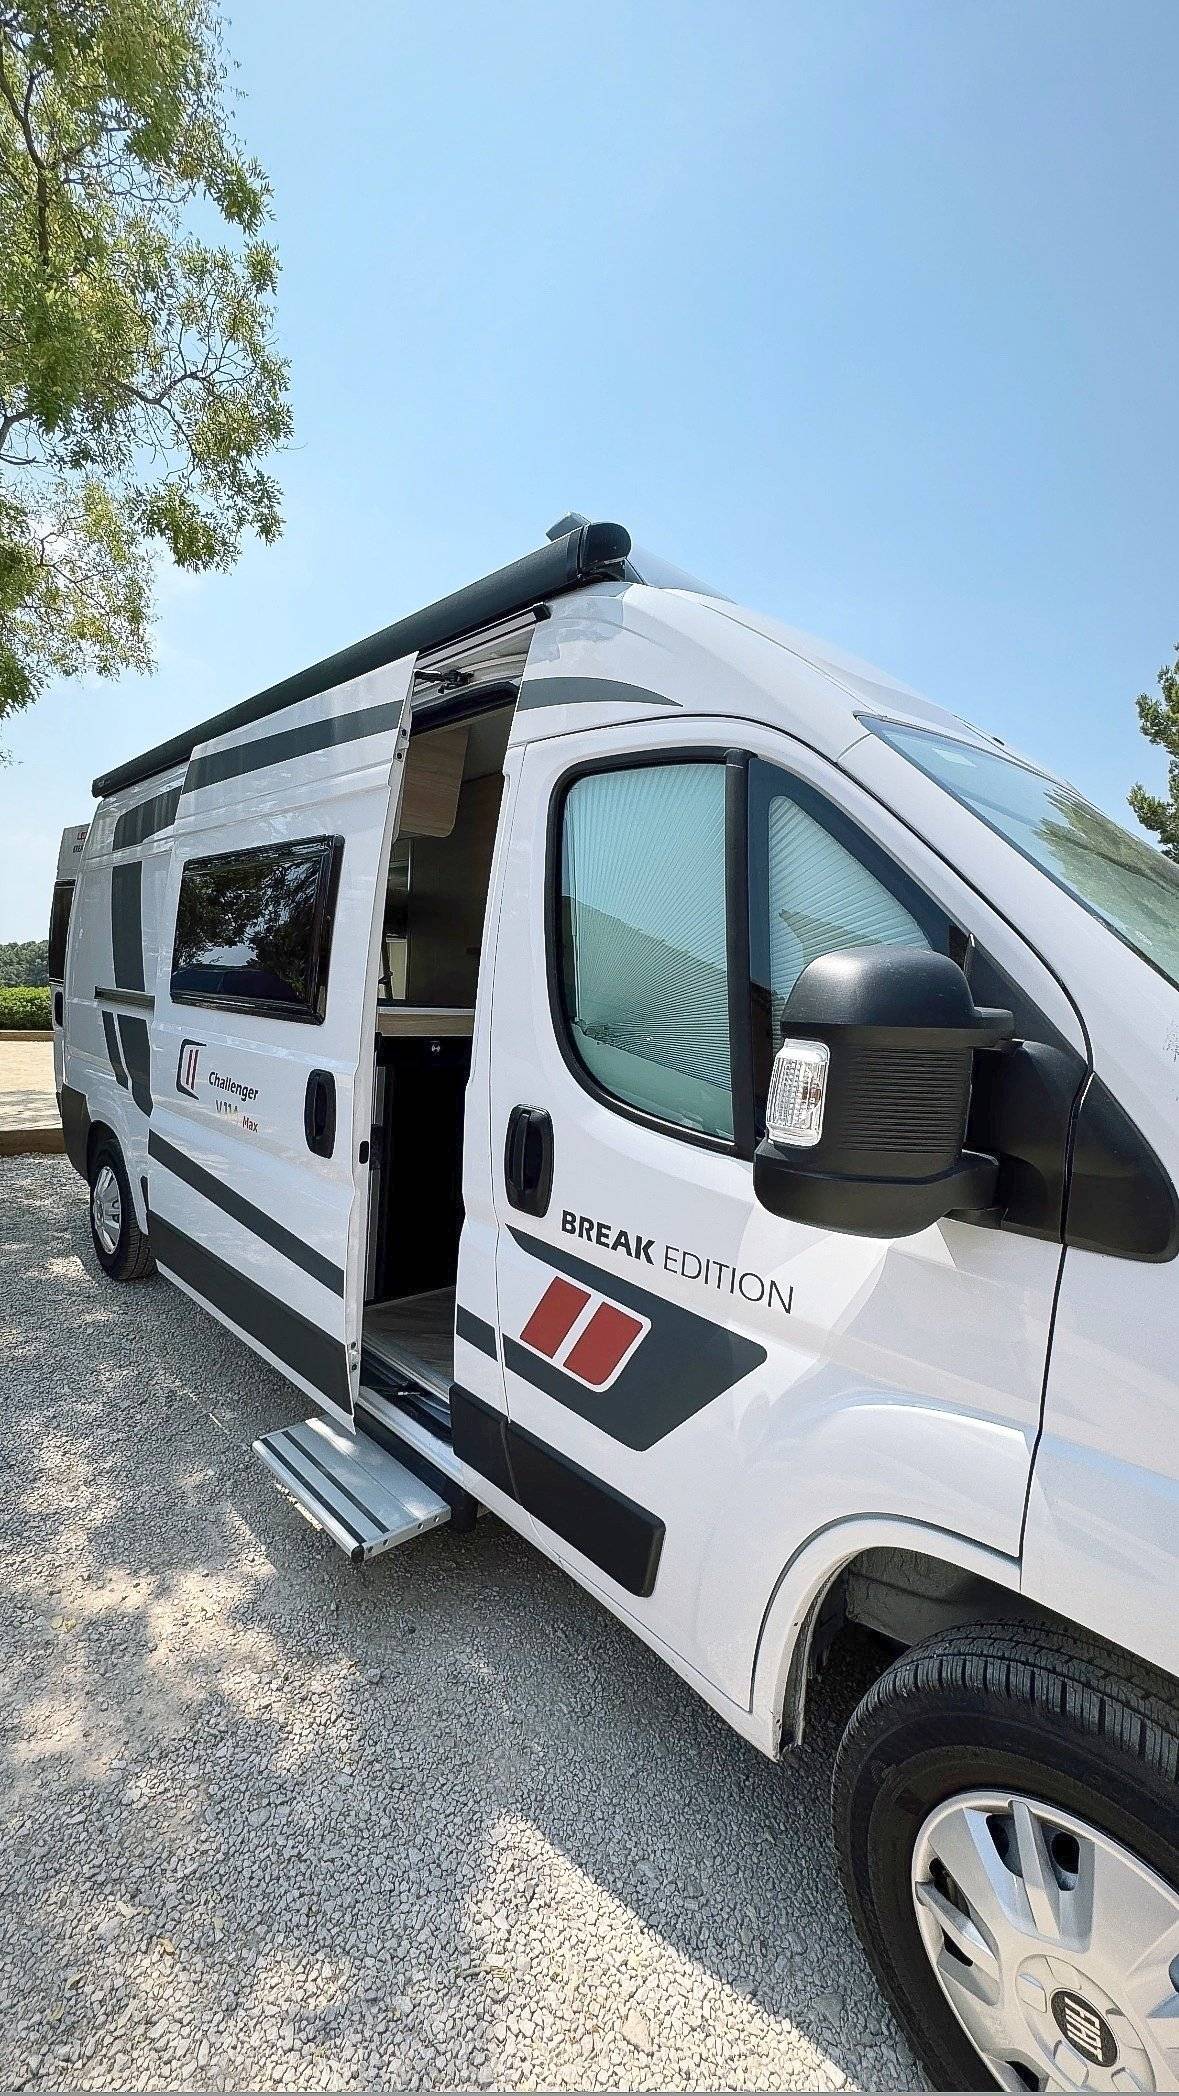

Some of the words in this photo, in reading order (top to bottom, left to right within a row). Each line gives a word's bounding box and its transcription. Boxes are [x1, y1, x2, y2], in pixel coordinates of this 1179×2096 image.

[208, 1071, 259, 1102] Challenger
[242, 1115, 258, 1132] Max
[561, 1209, 656, 1266] BREAK
[663, 1245, 794, 1314] EDITION
[1064, 1996, 1103, 2062] FIAT
